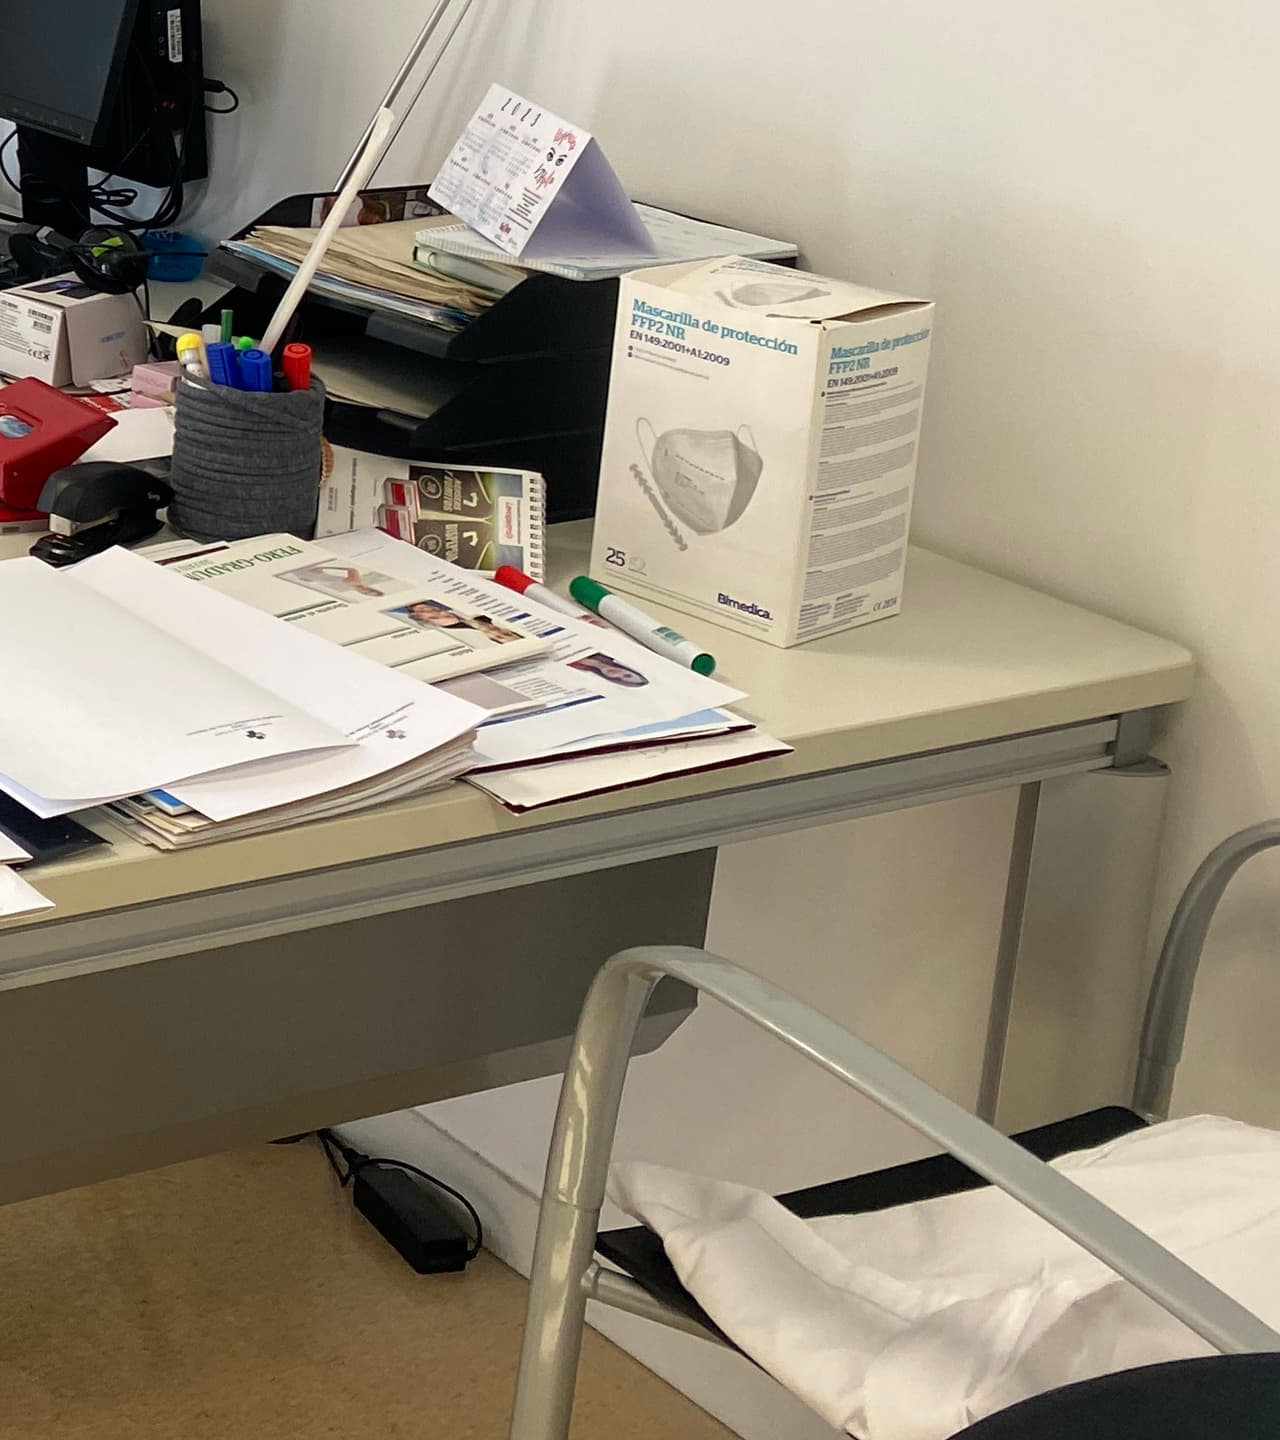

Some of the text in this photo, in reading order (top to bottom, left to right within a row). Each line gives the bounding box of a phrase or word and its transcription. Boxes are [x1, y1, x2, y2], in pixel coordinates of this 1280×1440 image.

[631, 314, 686, 341] FFP2 NR
[632, 298, 799, 355] Mascarilla de protección
[629, 330, 643, 342] EN
[644, 334, 731, 367] 149:2001+A1:2009
[831, 341, 880, 360] Mascarilla
[880, 338, 892, 351] de
[829, 357, 871, 375] FFP2 NR
[827, 379, 839, 389] EN
[605, 546, 626, 567] 25
